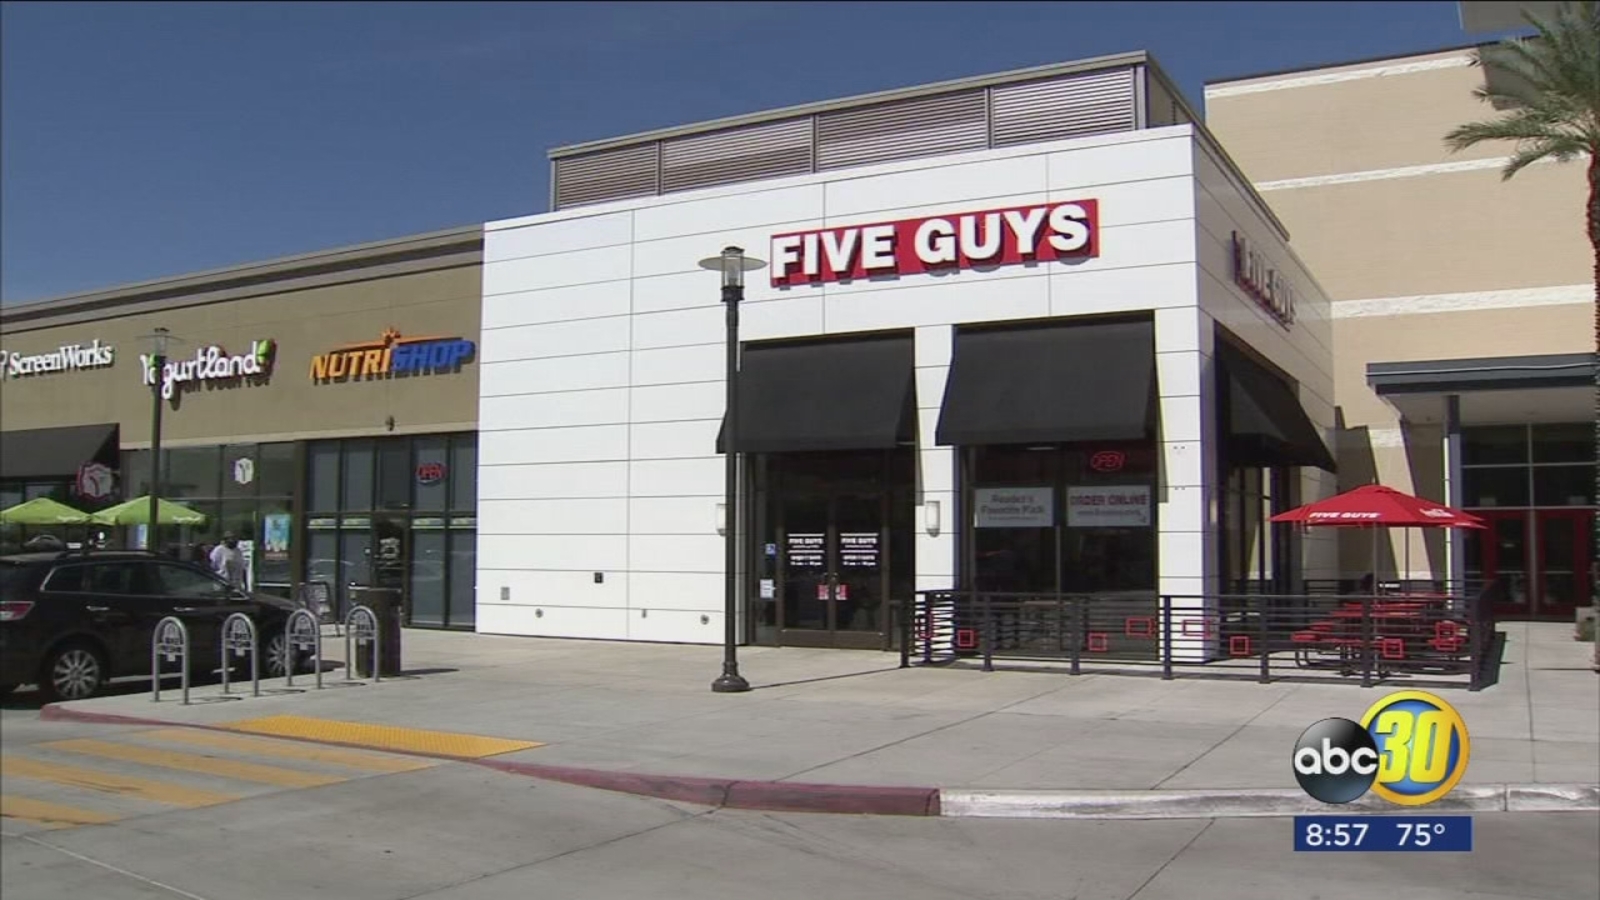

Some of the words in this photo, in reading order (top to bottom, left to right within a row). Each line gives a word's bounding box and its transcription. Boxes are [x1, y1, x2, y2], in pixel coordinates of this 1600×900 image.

[771, 225, 895, 278] FIVE
[914, 203, 1090, 265] GUYS
[9, 340, 114, 375] ScreenWorks
[309, 339, 475, 379] NUTRISHOP
[1309, 511, 1341, 519] FIVE
[1341, 511, 1381, 519] GUYS
